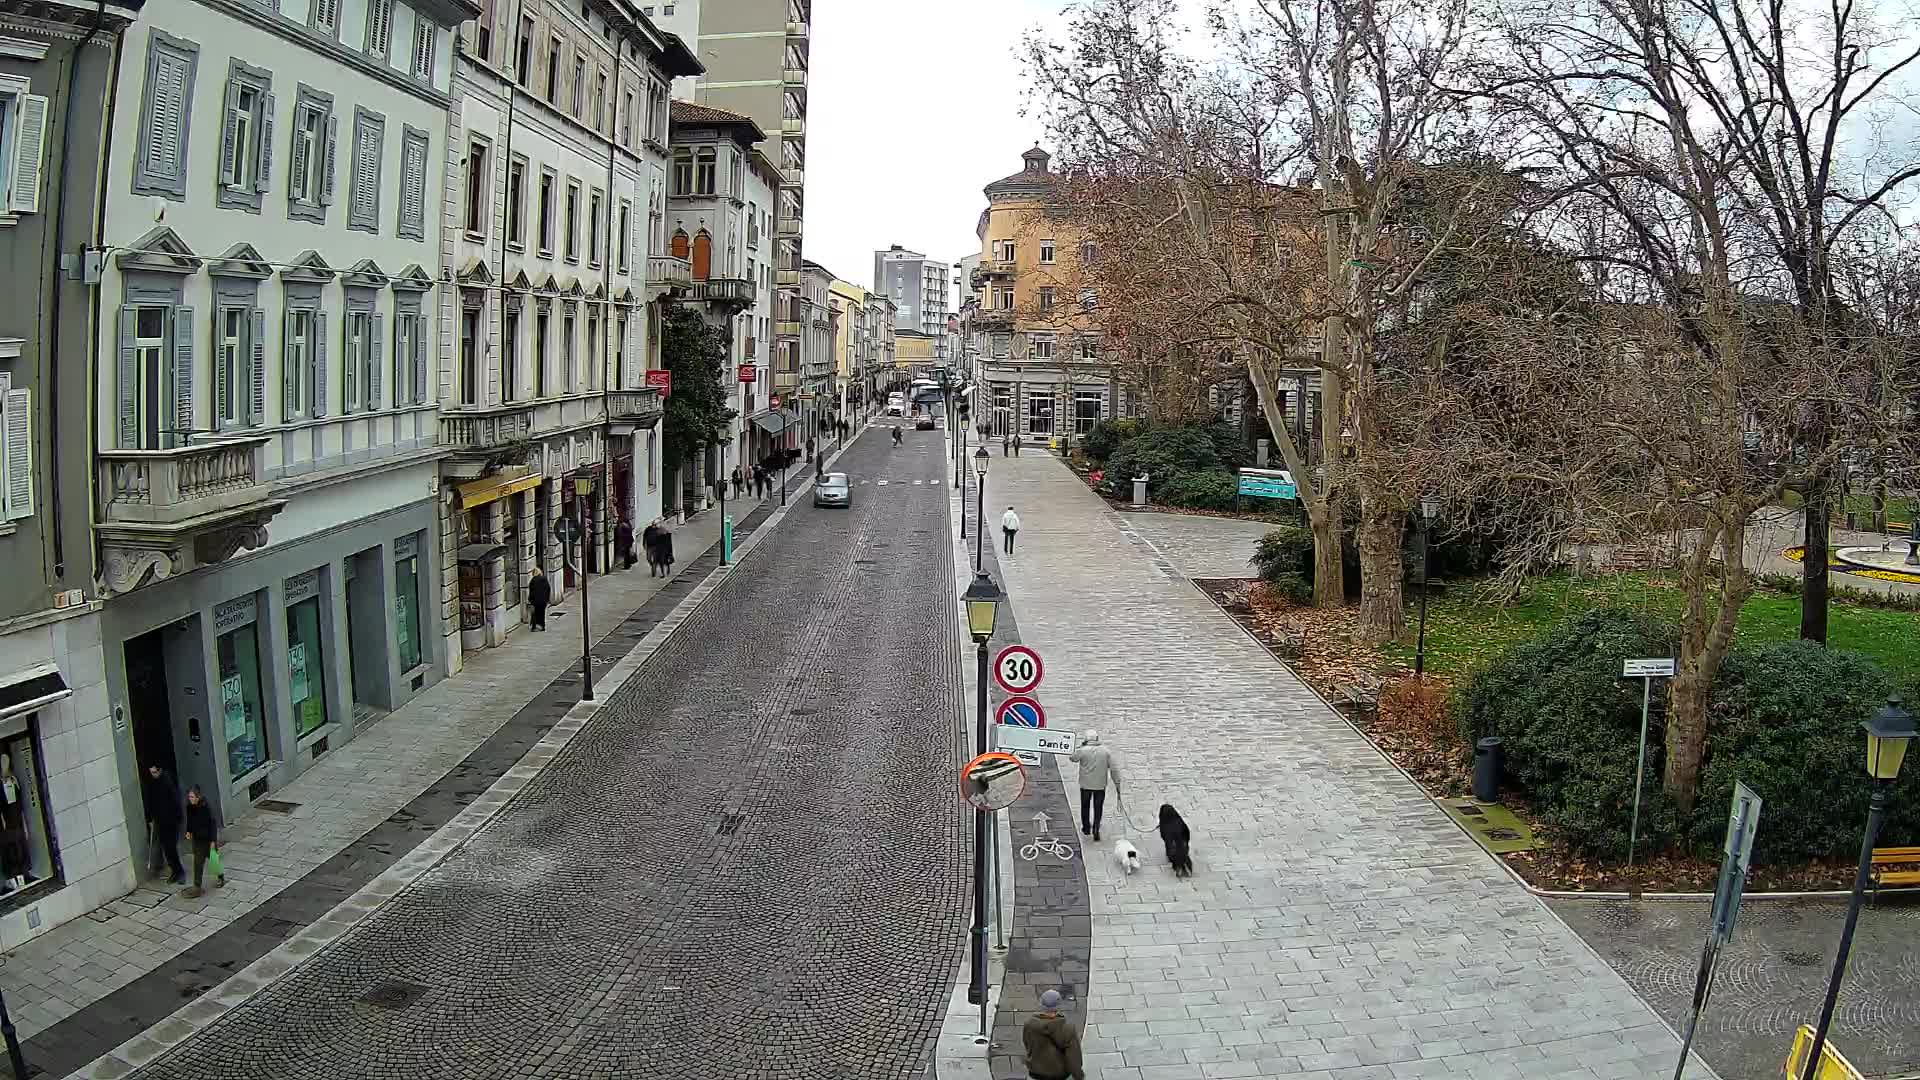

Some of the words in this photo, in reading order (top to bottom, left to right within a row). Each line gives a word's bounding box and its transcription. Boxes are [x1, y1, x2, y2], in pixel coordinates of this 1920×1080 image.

[1005, 658, 1033, 681] 30
[223, 678, 241, 701] 130
[1038, 738, 1070, 750] Dante
